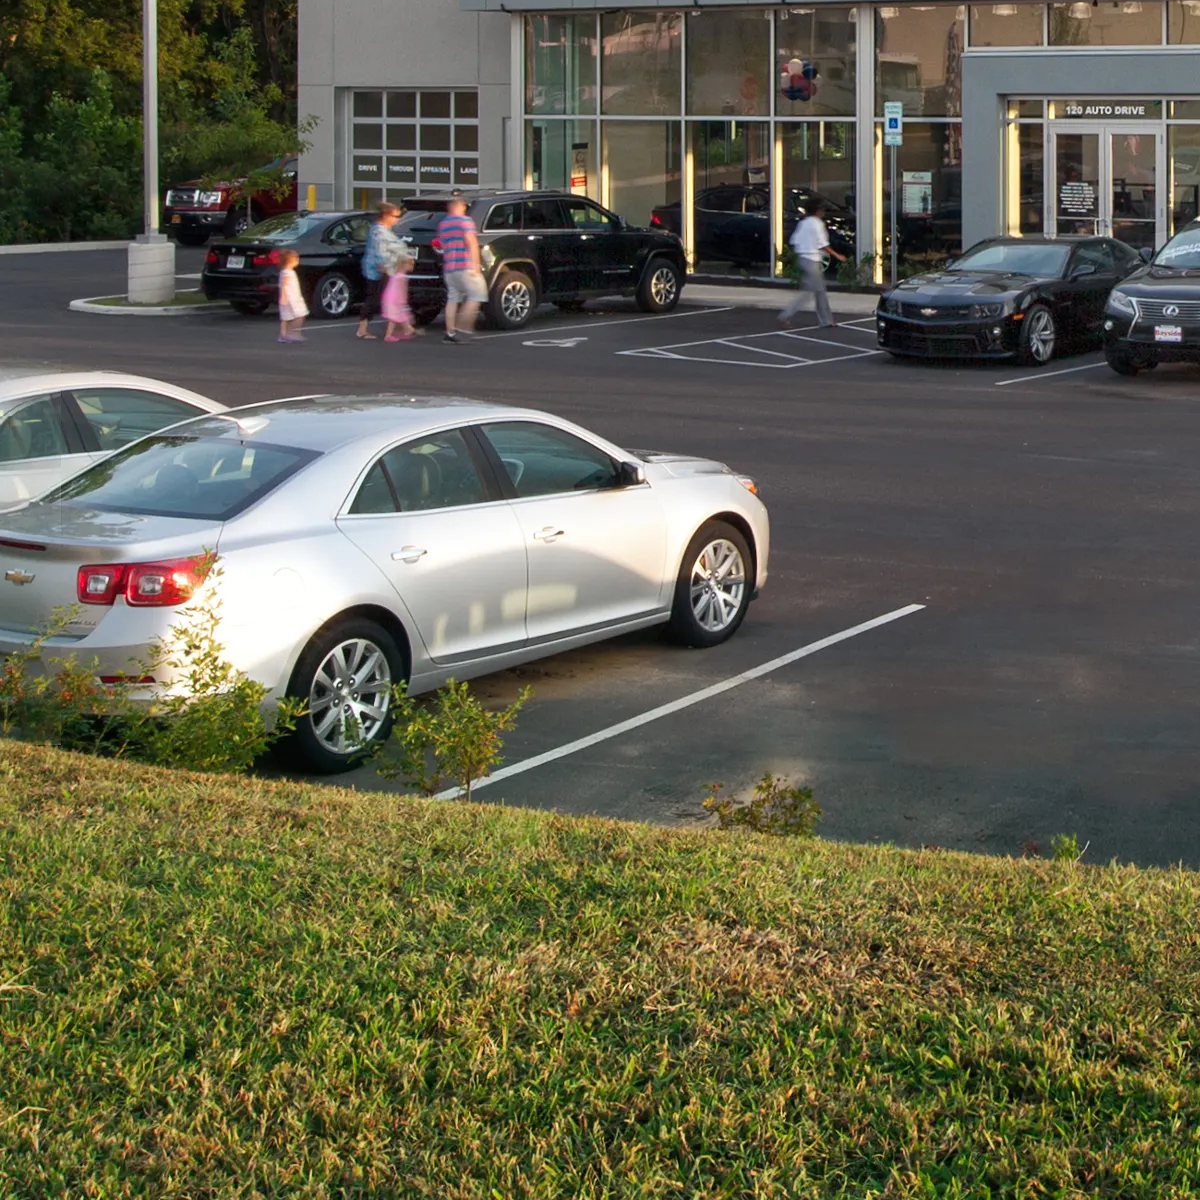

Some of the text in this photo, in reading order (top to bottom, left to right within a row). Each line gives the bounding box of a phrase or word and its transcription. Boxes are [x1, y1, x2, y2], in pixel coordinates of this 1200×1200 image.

[1065, 106, 1145, 115] 120 AUTO DRIVE
